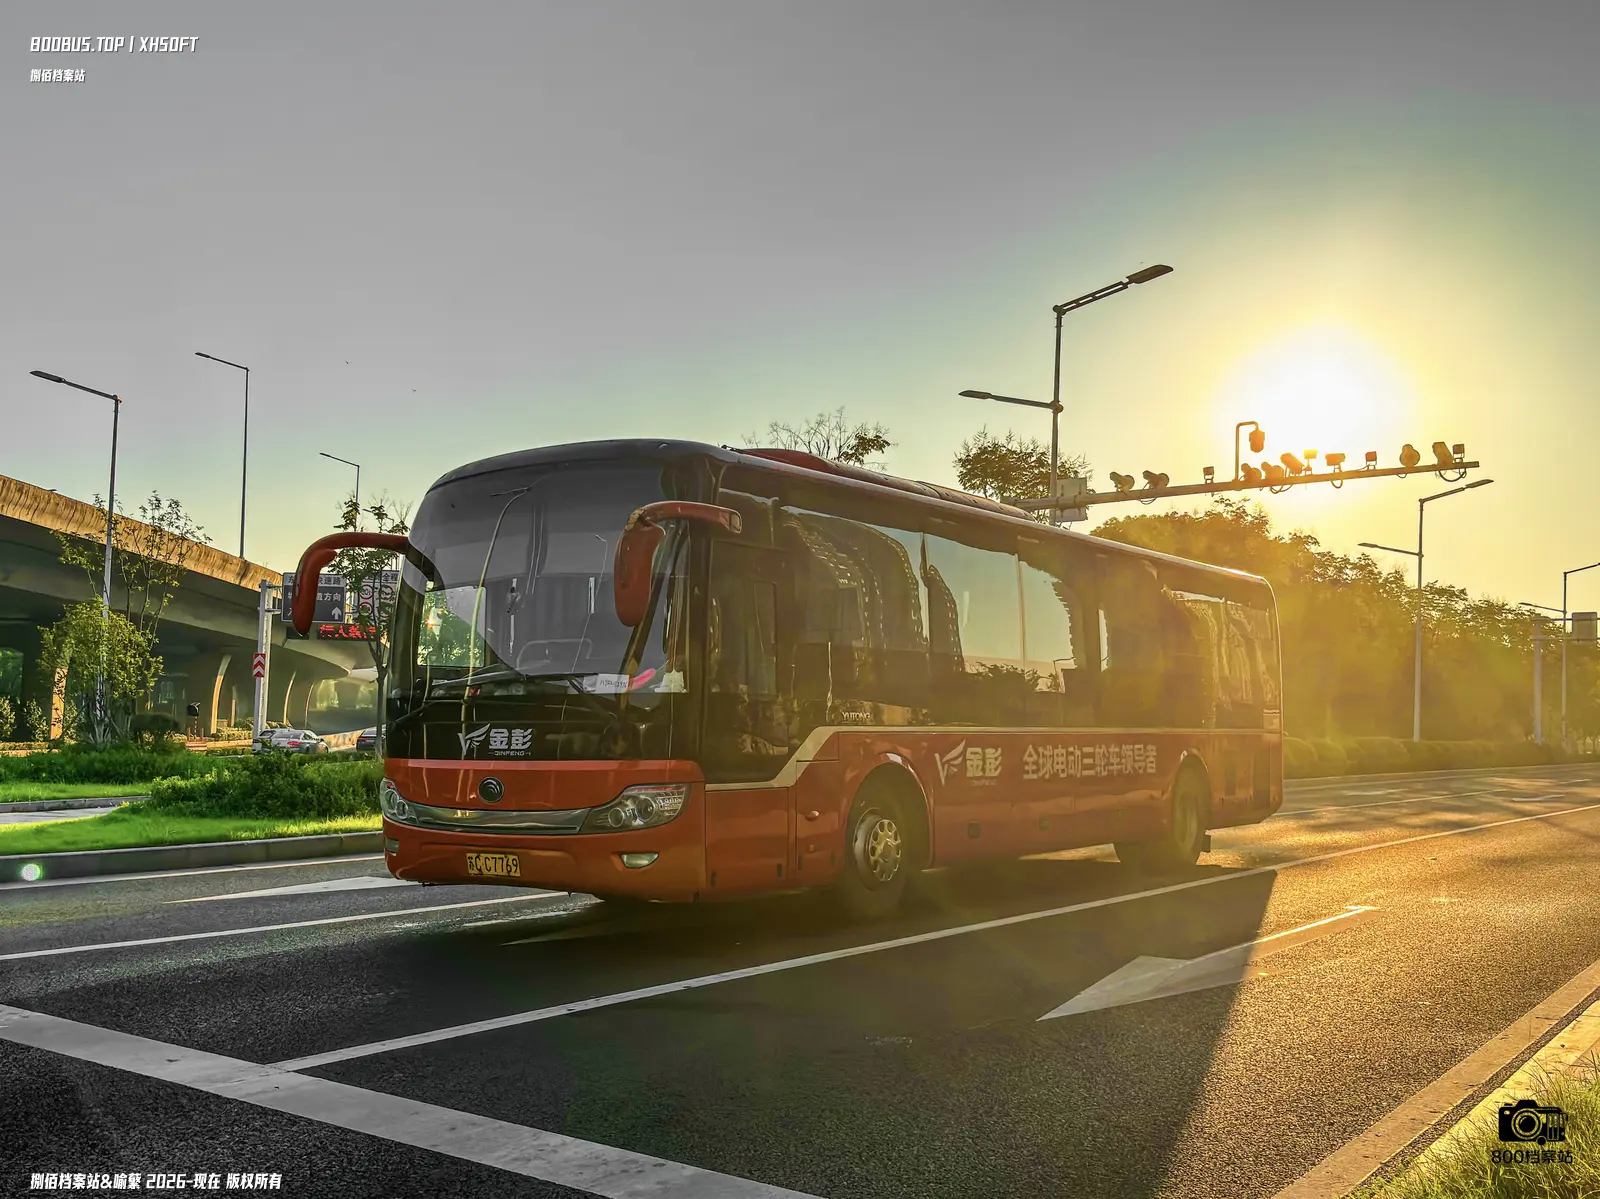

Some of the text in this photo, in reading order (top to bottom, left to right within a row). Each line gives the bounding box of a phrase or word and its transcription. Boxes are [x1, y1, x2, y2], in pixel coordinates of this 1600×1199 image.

[841, 711, 871, 721] YUTONG
[489, 728, 533, 750] 金彭
[965, 747, 1002, 778] 金彭
[1022, 743, 1157, 780] 全球电动三轮车领导者
